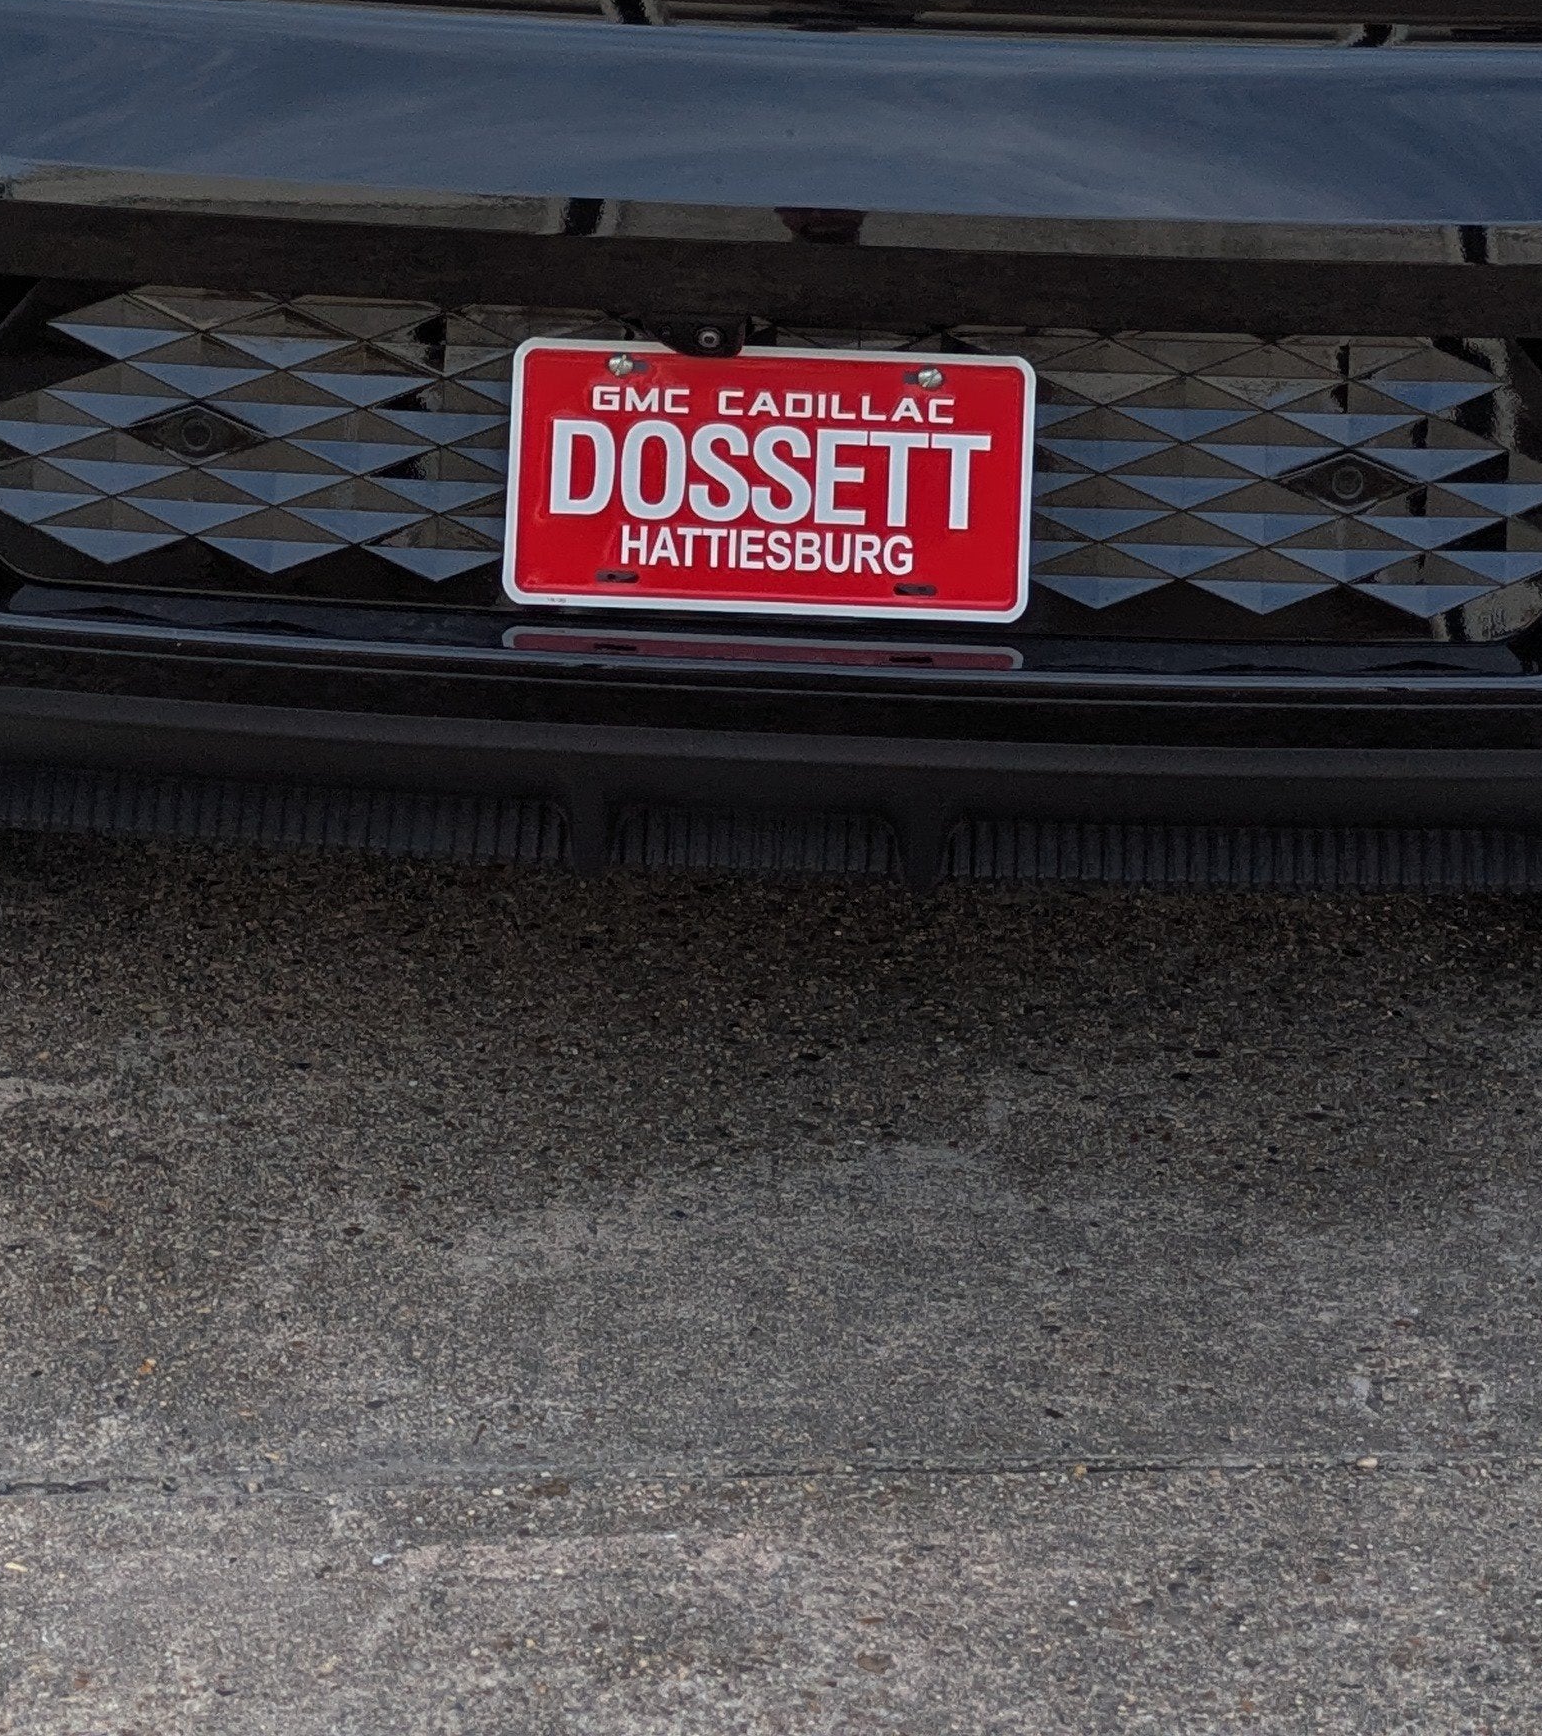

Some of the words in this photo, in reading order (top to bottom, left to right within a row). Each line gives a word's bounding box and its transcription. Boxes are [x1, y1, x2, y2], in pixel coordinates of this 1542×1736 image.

[591, 385, 690, 415] GMC
[717, 389, 956, 424] CADILLAC
[548, 418, 992, 530] DOSSETT
[620, 524, 915, 576] HATTIESBURG
